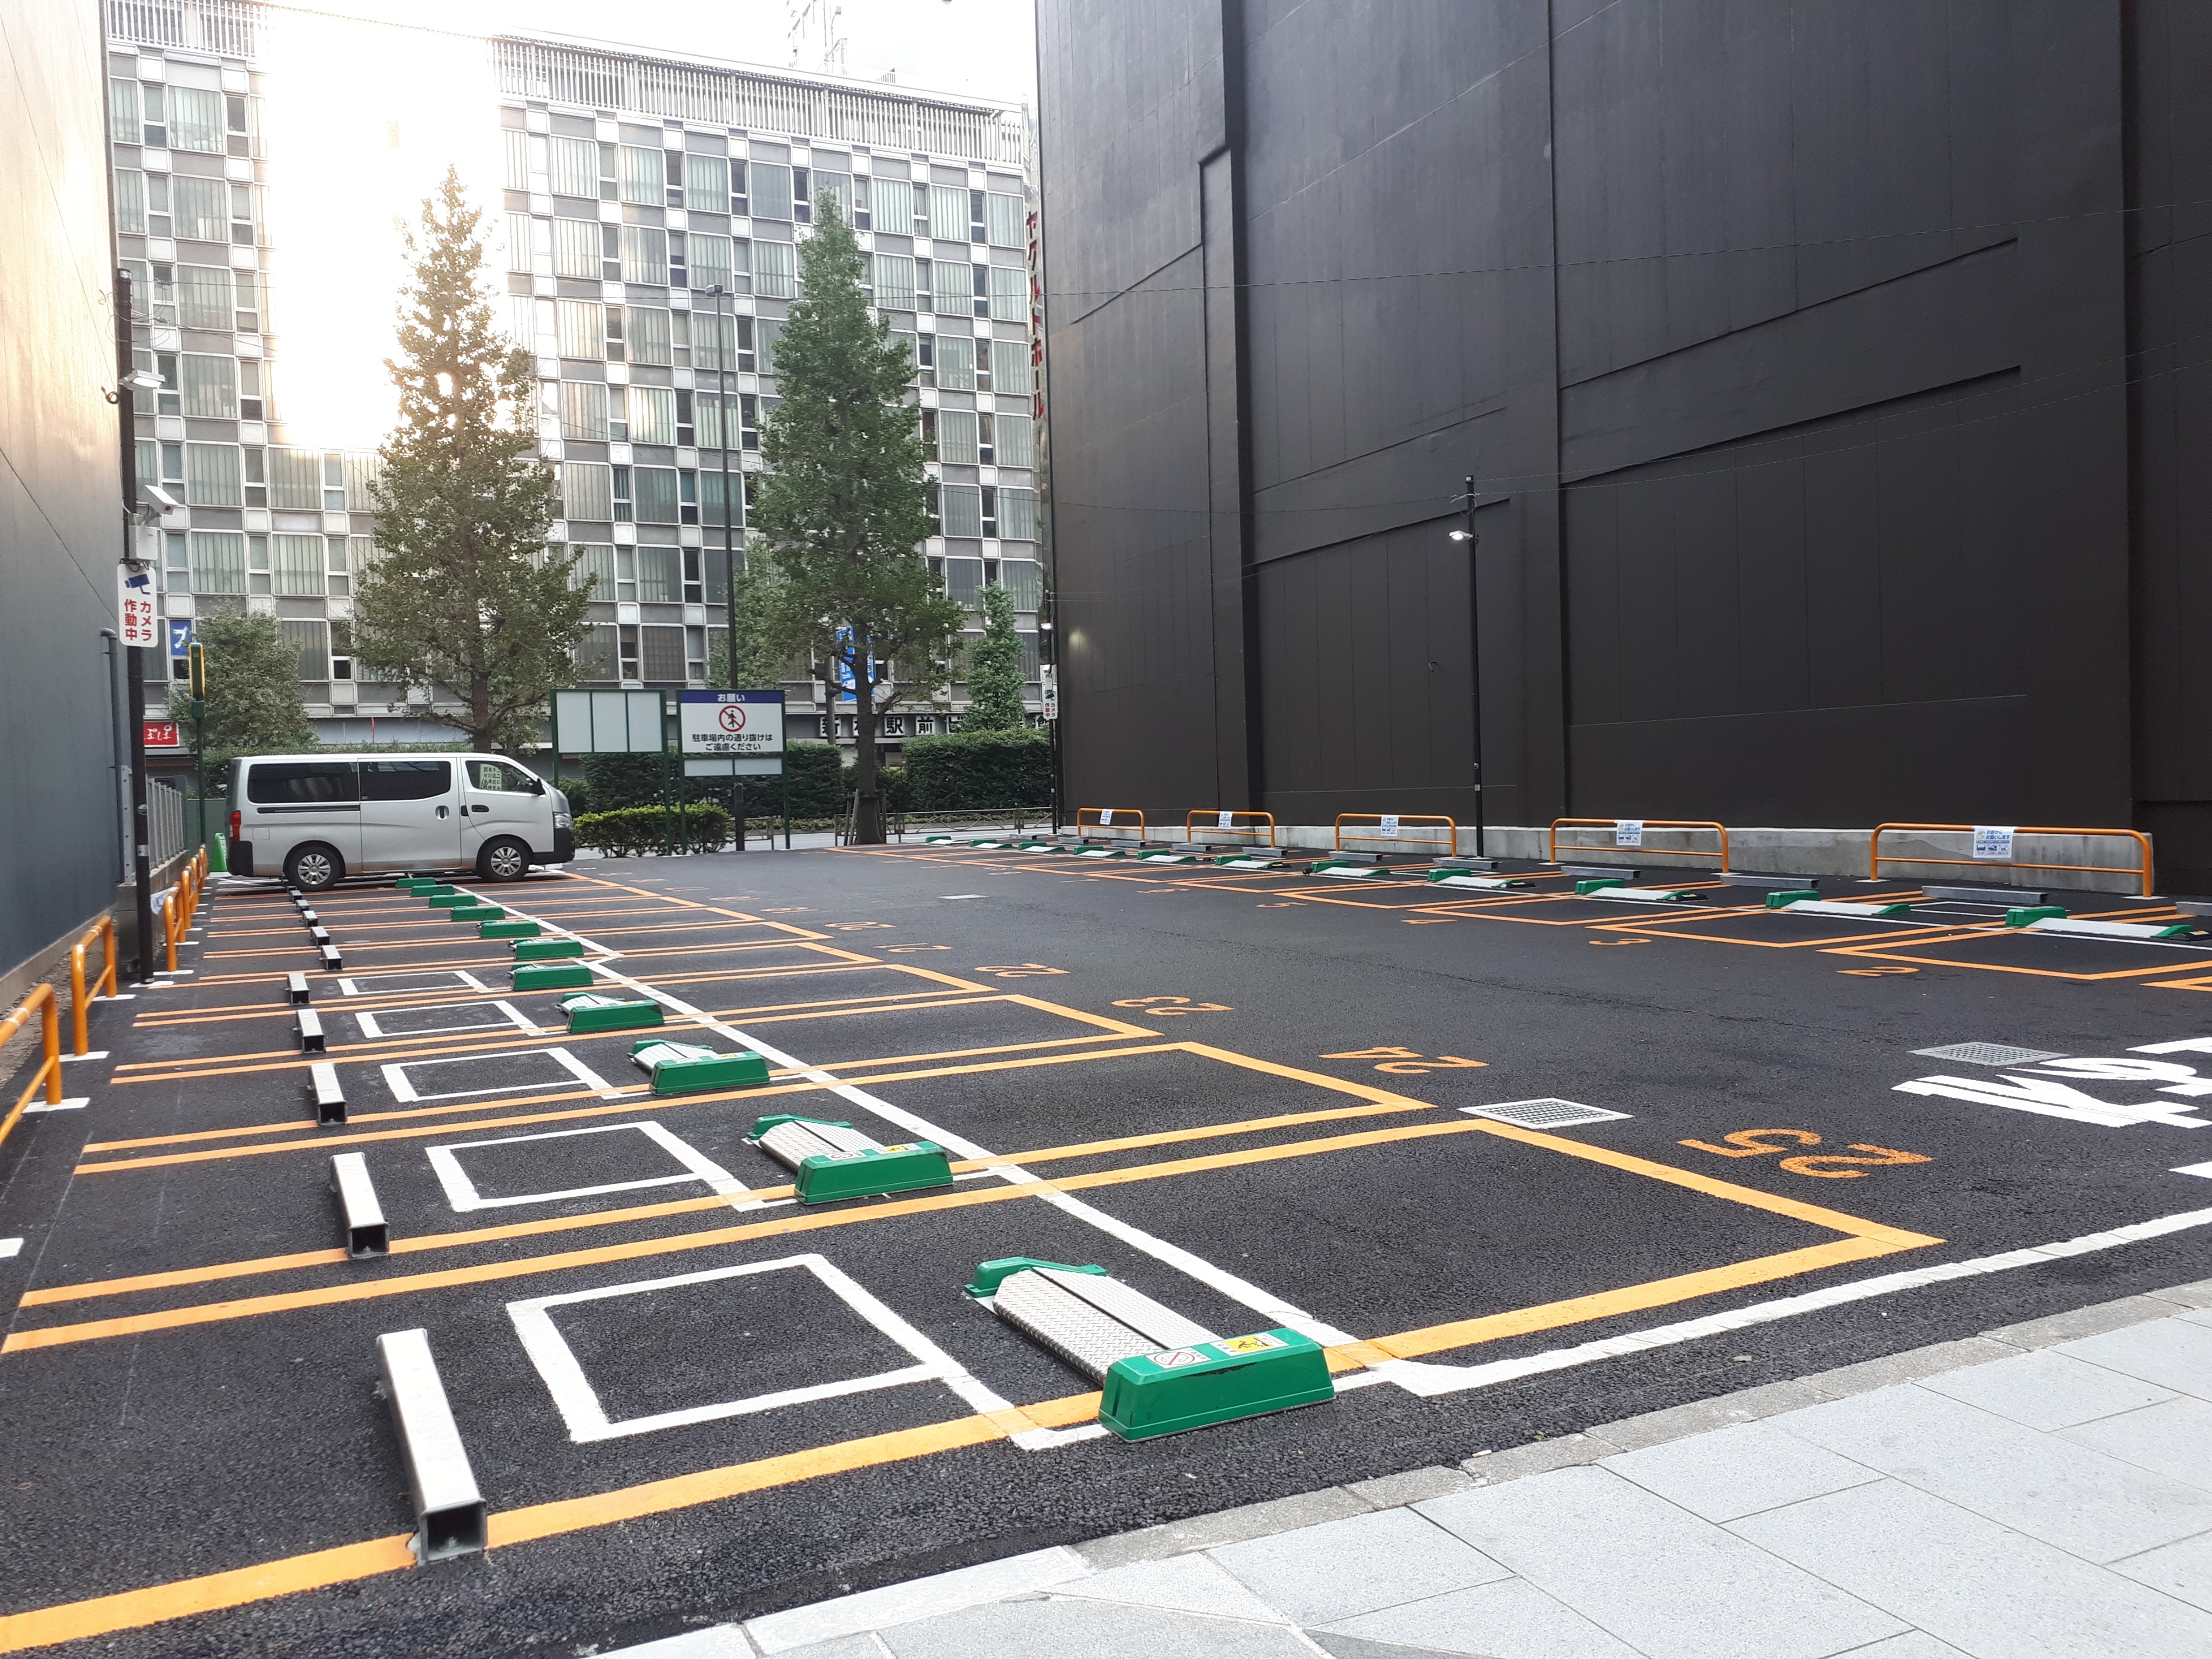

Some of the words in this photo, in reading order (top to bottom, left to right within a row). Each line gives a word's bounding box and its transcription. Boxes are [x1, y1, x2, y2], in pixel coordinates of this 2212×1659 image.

[124, 598, 138, 641] 作動中
[140, 601, 152, 641] カメラ
[717, 693, 746, 703] お願い
[692, 733, 773, 742] 駐車場内の通り抜けは
[705, 743, 761, 751] ご遠慮ください
[825, 921, 896, 930] 20
[872, 942, 953, 953] 21
[974, 963, 1071, 977] 22
[1836, 966, 1920, 977] 2
[1111, 996, 1235, 1015] 23
[1318, 1047, 1489, 1074] 24
[1677, 1128, 1934, 1179] 25
